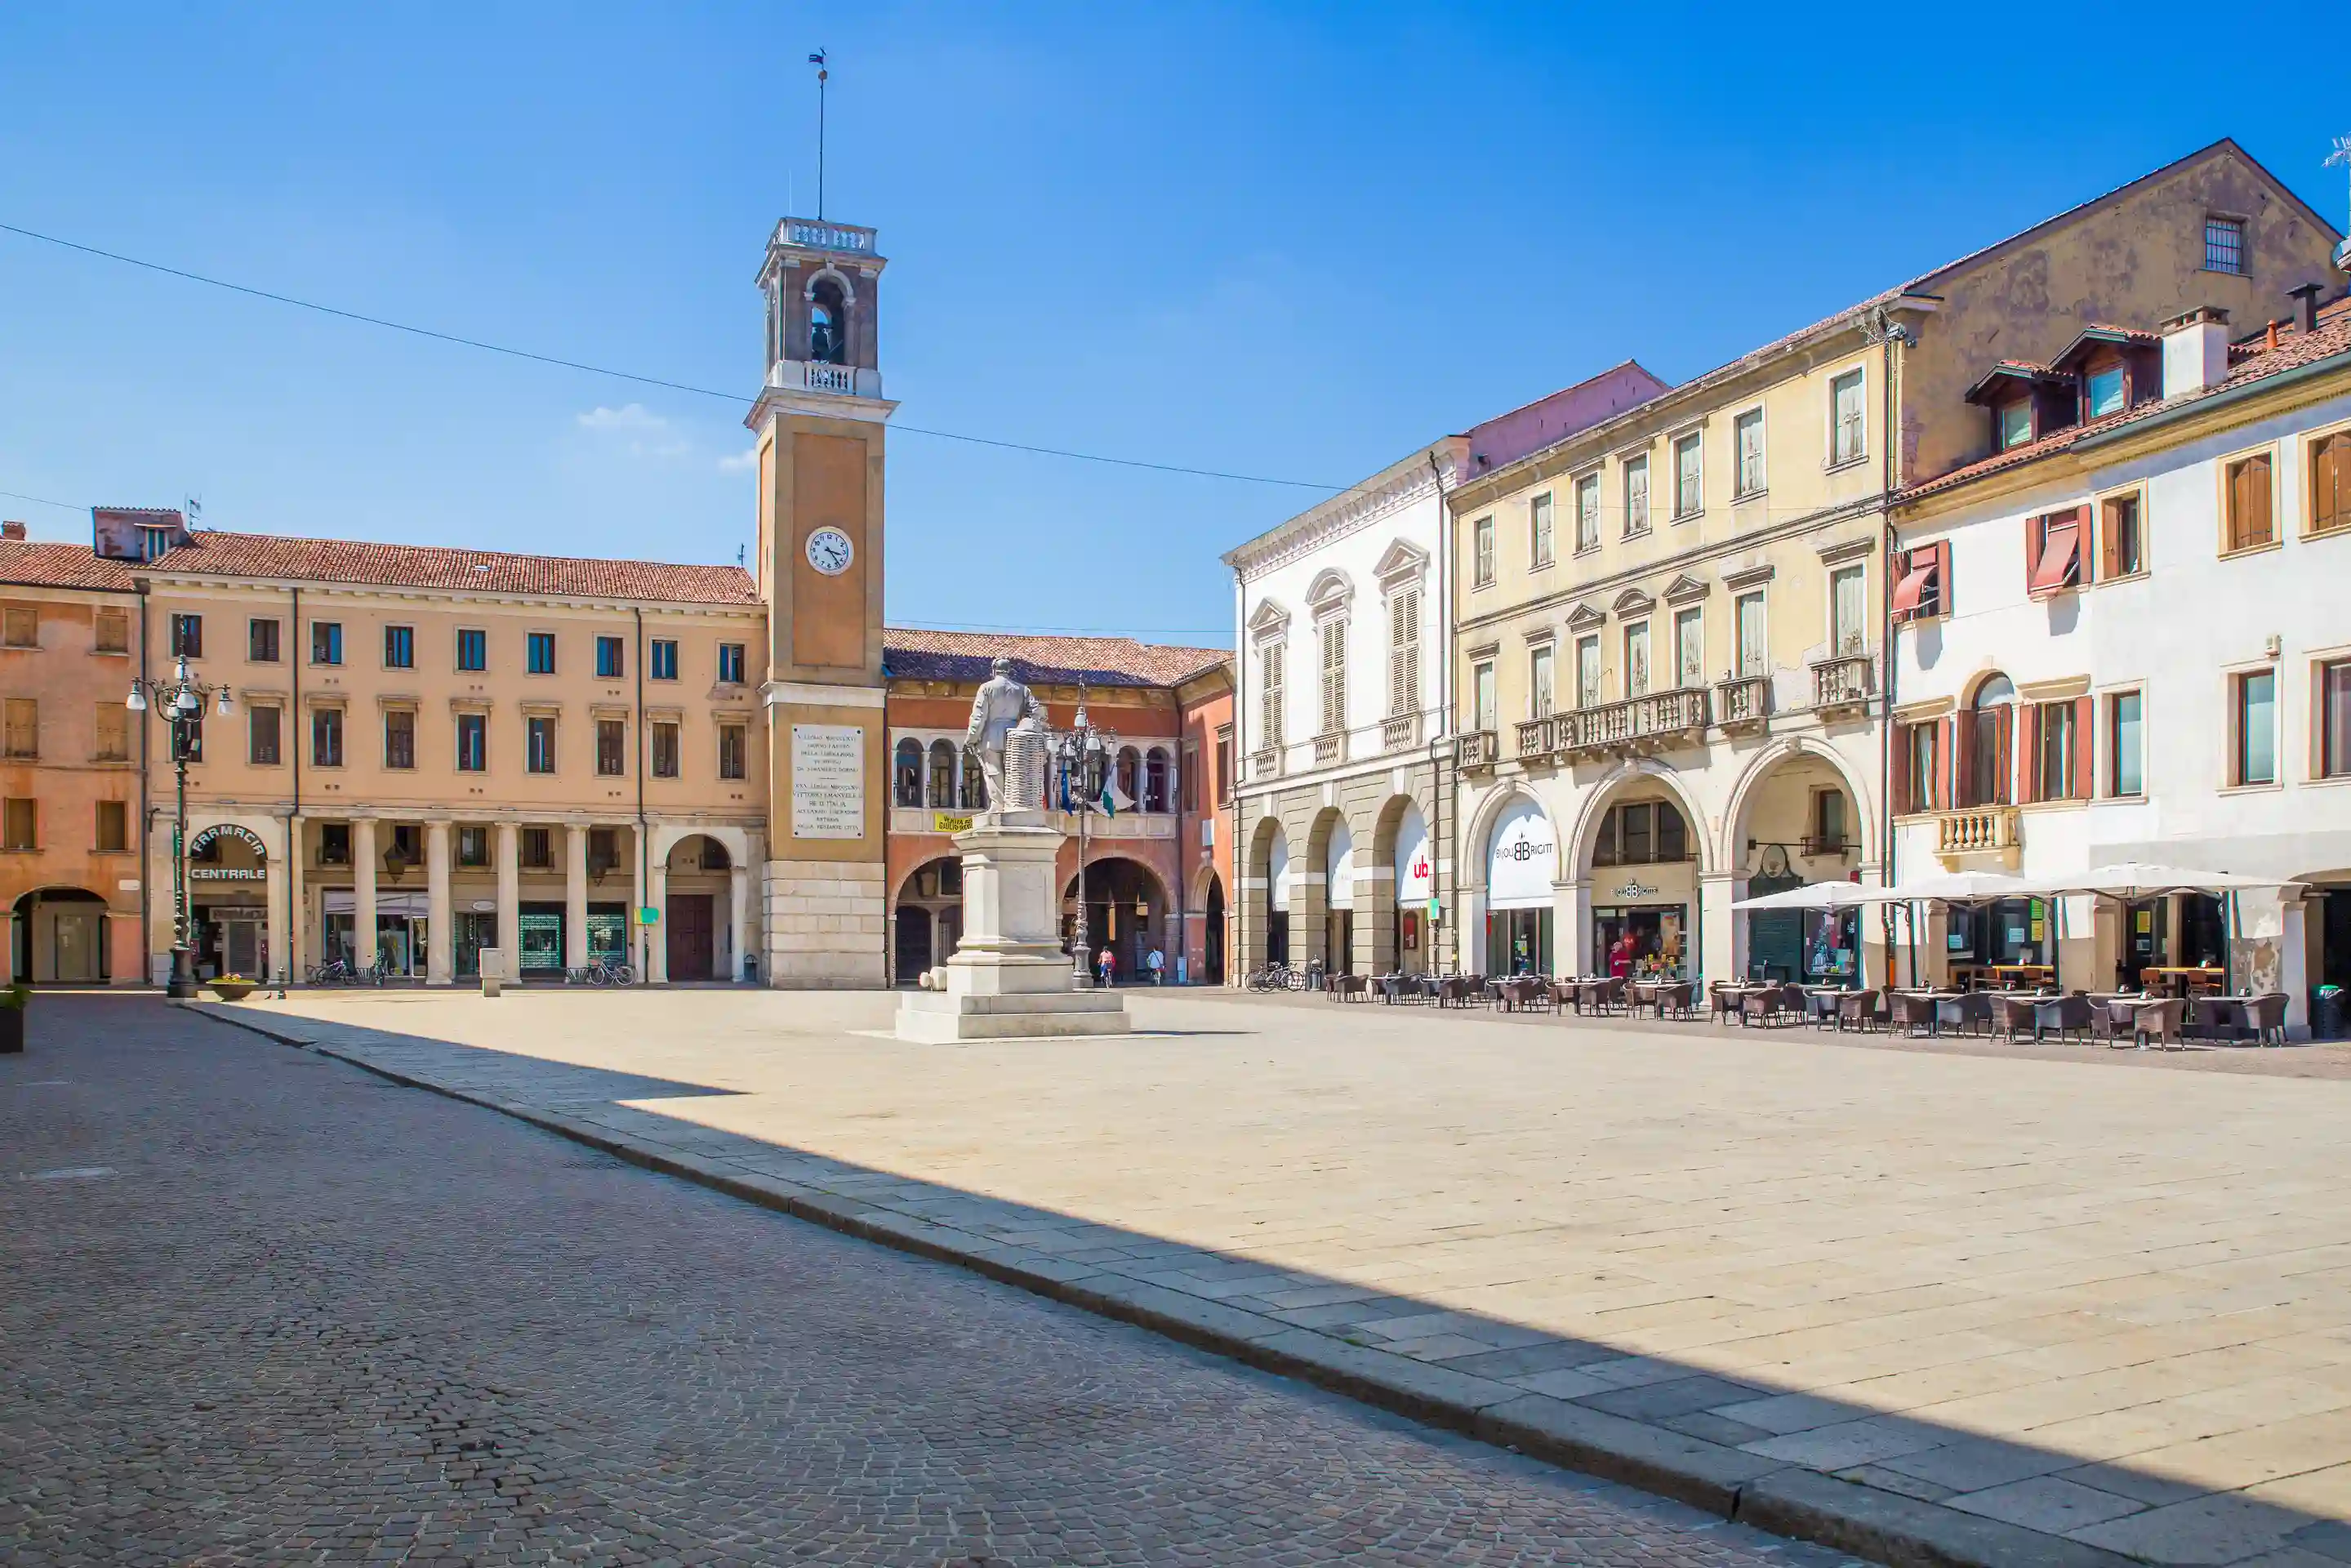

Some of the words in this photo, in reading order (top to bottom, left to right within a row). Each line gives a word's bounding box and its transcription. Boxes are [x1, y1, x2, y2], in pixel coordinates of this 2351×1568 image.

[938, 822, 959, 831] GIULIO
[192, 825, 265, 856] FARMACIA
[191, 869, 265, 879] CENTRALE
